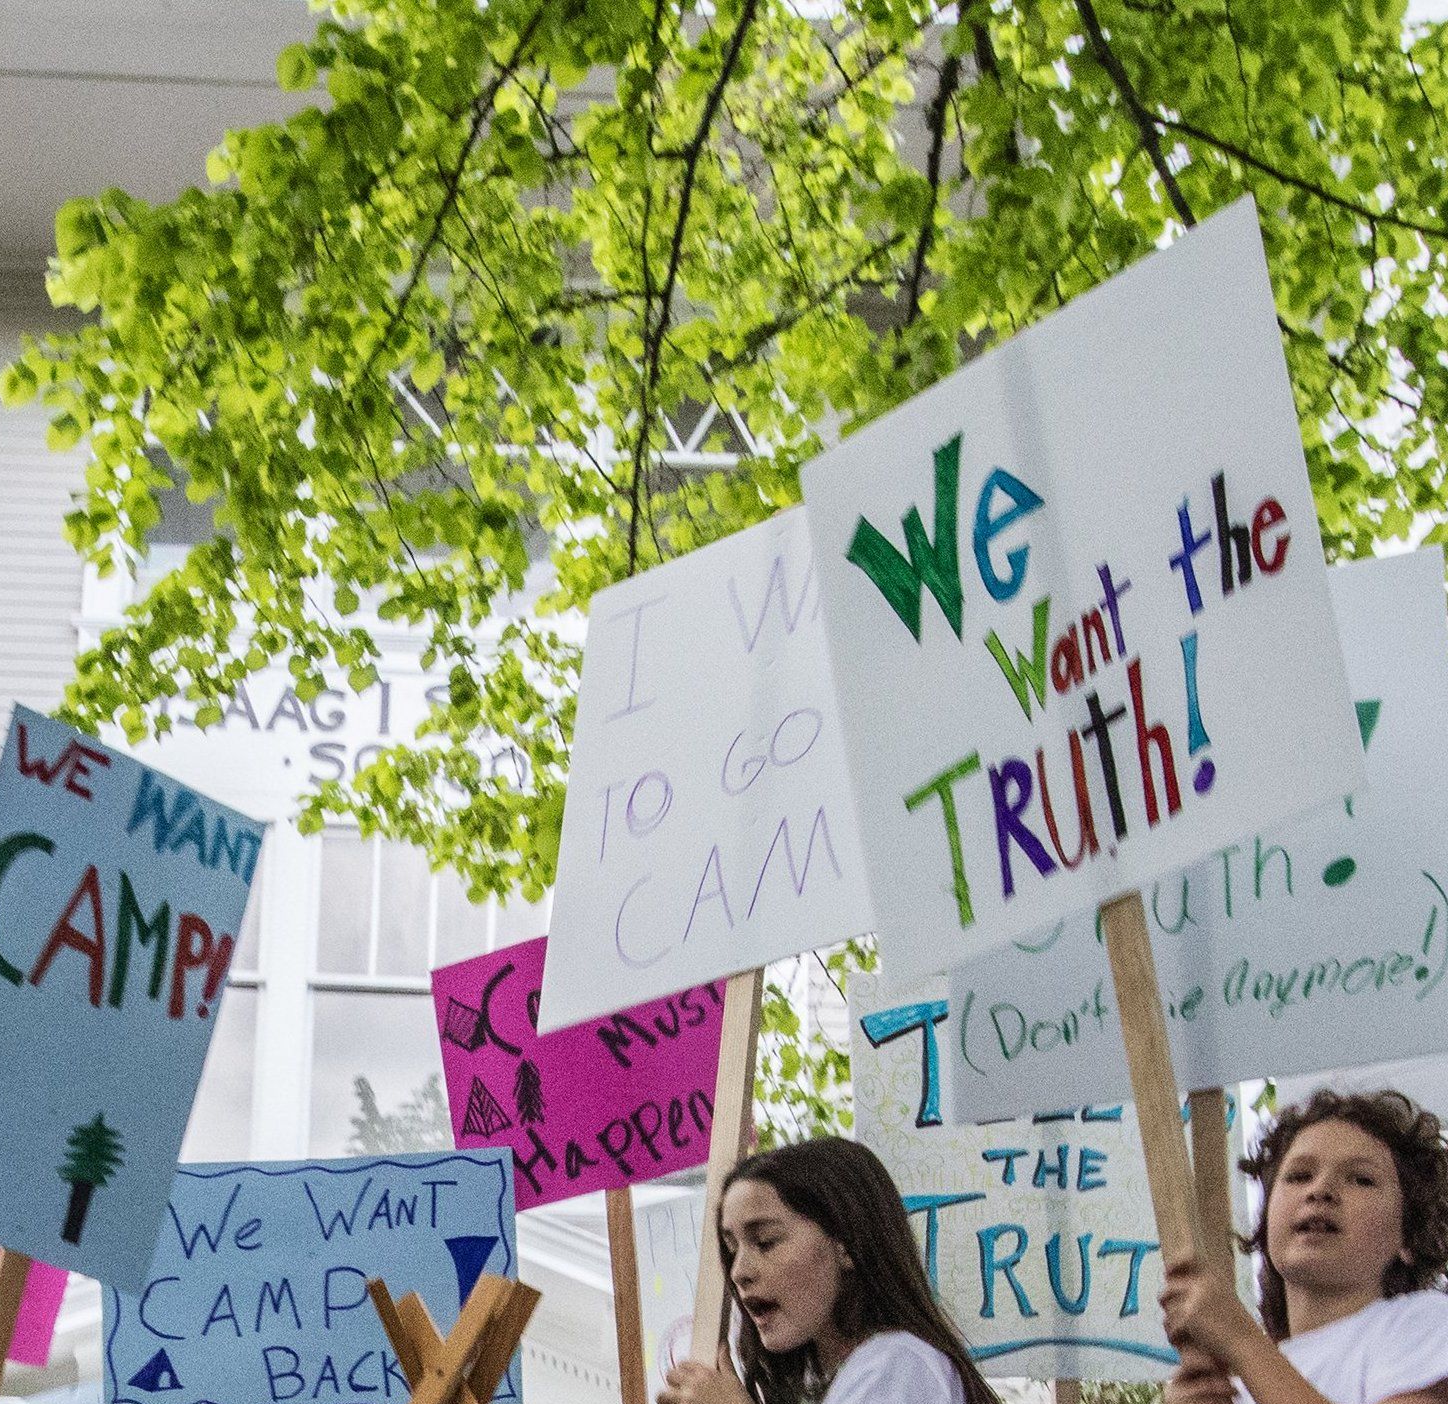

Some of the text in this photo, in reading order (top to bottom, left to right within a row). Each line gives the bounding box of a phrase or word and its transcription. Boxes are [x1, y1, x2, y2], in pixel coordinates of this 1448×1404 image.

[846, 430, 1046, 646] We
[1168, 468, 1293, 616] the
[605, 593, 666, 723] I
[15, 722, 263, 887] WE WANT
[598, 705, 824, 865] TO GO
[614, 803, 843, 970] CAM
[511, 1087, 716, 1197] Happen
[982, 1142, 1109, 1191] THE
[168, 1177, 459, 1260] We WANT
[902, 1191, 1160, 1321] TRUT
[138, 1265, 371, 1341] CAMP
